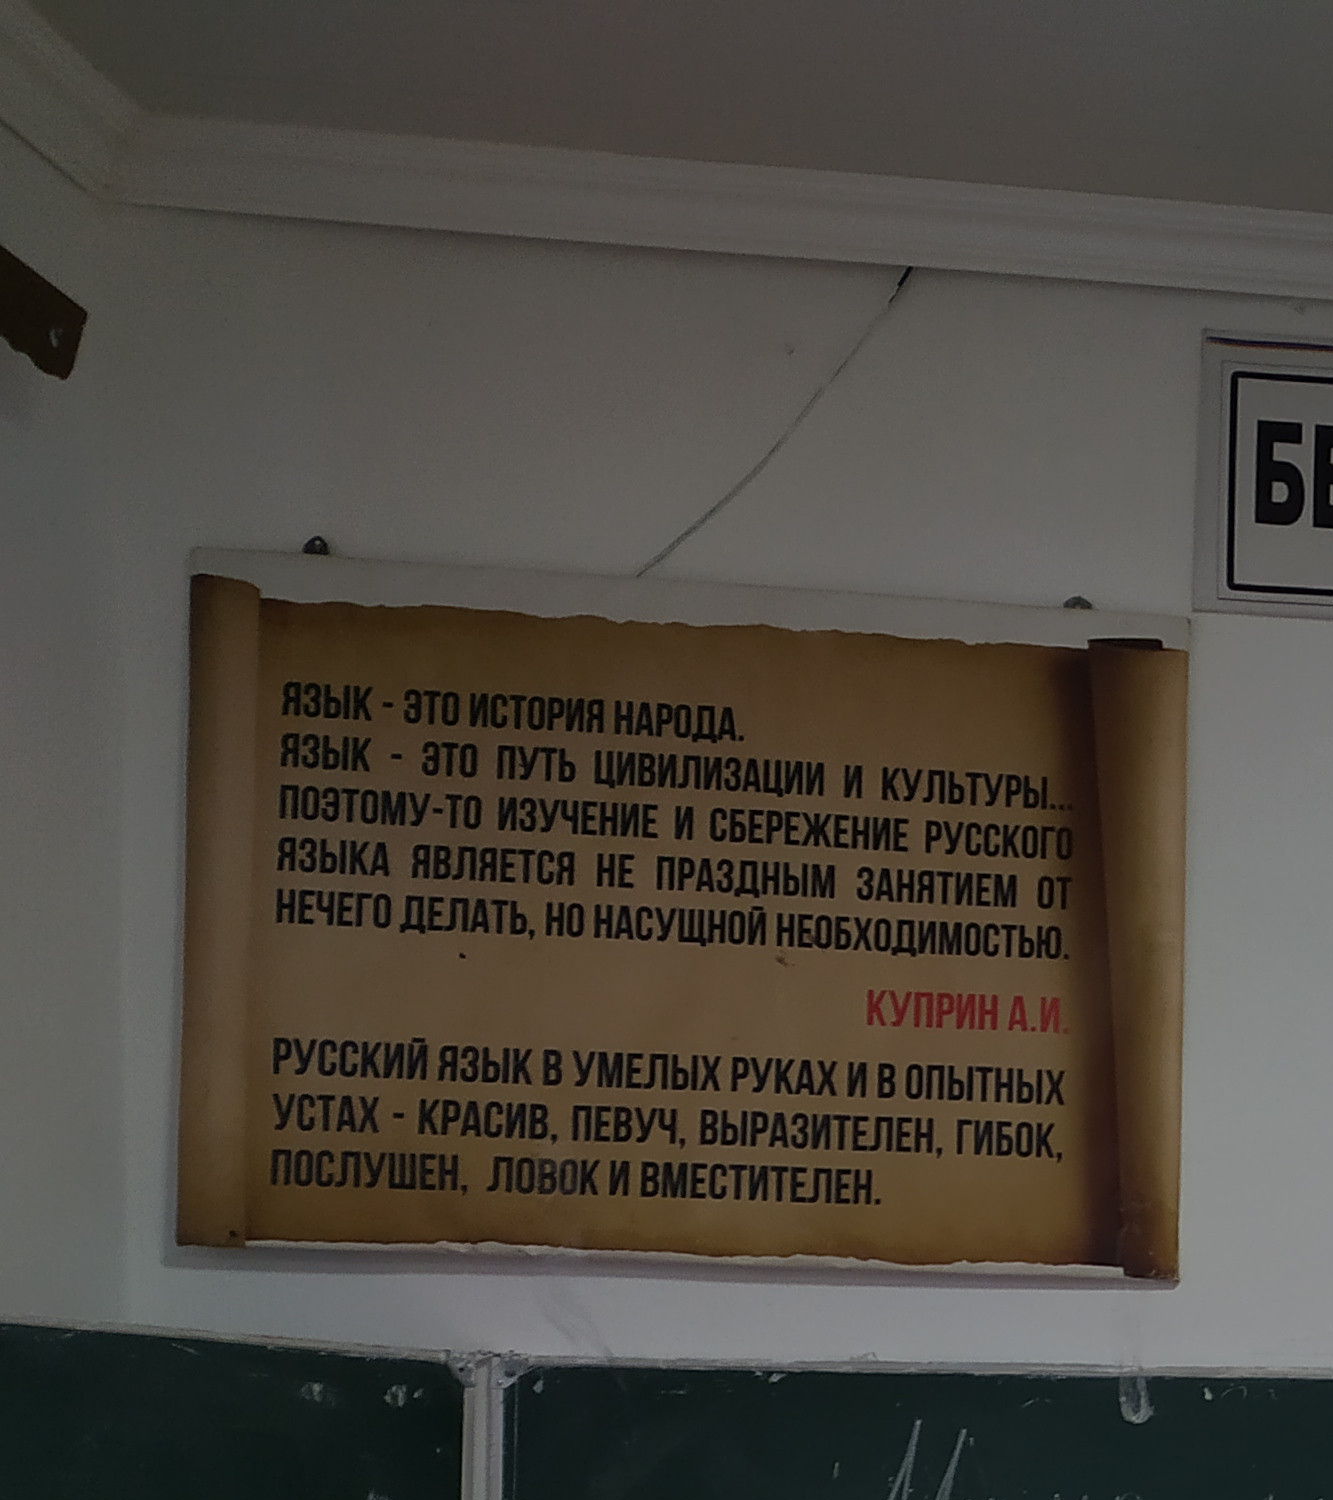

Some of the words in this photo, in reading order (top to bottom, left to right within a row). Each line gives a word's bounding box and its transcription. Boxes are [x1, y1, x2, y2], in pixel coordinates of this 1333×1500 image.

[282, 682, 373, 721] ЯЗЫК
[404, 689, 459, 726] ЭТО
[470, 693, 604, 733] ИСТОРИЯ
[615, 701, 744, 743] НАРОДА.
[280, 733, 371, 772] ЯЗЫК
[422, 742, 478, 777] ЭТО
[497, 745, 576, 782] ПУТЬ
[595, 750, 824, 797] ЦИВИЛИЗАЦИИ
[844, 765, 863, 798] И
[882, 767, 1071, 810] КУЛЬТУРЫ...
[279, 785, 482, 829] ПОЭТОМУ-ТО
[498, 797, 658, 838] ИЗУЧЕНИЕ
[675, 806, 694, 840] И
[710, 808, 909, 852] СБЕРЕЖЕНИЕ
[926, 820, 1073, 860] РУССКОГО
[277, 837, 390, 876] ЯЗЫКА
[412, 845, 575, 886] ЯВЛЯЕТСЯ
[597, 853, 635, 888] НЕ
[657, 856, 835, 898] ПРАЗДНЫМ
[857, 867, 1017, 907] ЗАНЯТИЕМ
[1038, 876, 1072, 909] ОТ
[276, 888, 391, 928] НЕЧЕГО
[400, 895, 535, 940] ДЕЛАТЬ,
[546, 902, 584, 937] НО
[594, 904, 766, 947] НАСУЩНОЙ
[777, 913, 1070, 960] НЕОБХОДИМОСТЬЮ.
[867, 989, 998, 1030] КУПРИН
[1008, 996, 1067, 1033] А.И.
[273, 1038, 428, 1080] РУССКИЙ
[438, 1046, 532, 1084] ЯЗЫК
[543, 1049, 562, 1085] В
[573, 1050, 721, 1091] УМЕЛЫХ
[731, 1057, 837, 1096] РУКАХ
[847, 1062, 867, 1097] И
[878, 1063, 896, 1098] В
[906, 1064, 1065, 1105] ОПЫТНЫХ
[272, 1093, 379, 1133] УСТАХ
[418, 1099, 557, 1143] КРАСИВ,
[572, 1105, 685, 1148] ПЕВУЧ,
[700, 1110, 942, 1158] ВЫРАЗИТЕЛЕН,
[956, 1119, 1062, 1163] ГИБОК,
[271, 1149, 467, 1195] ПОСЛУШЕН,
[486, 1156, 600, 1195] ЛОВОК
[609, 1160, 630, 1196] И
[641, 1162, 881, 1205] ВМЕСТИТЕЛЕН.
